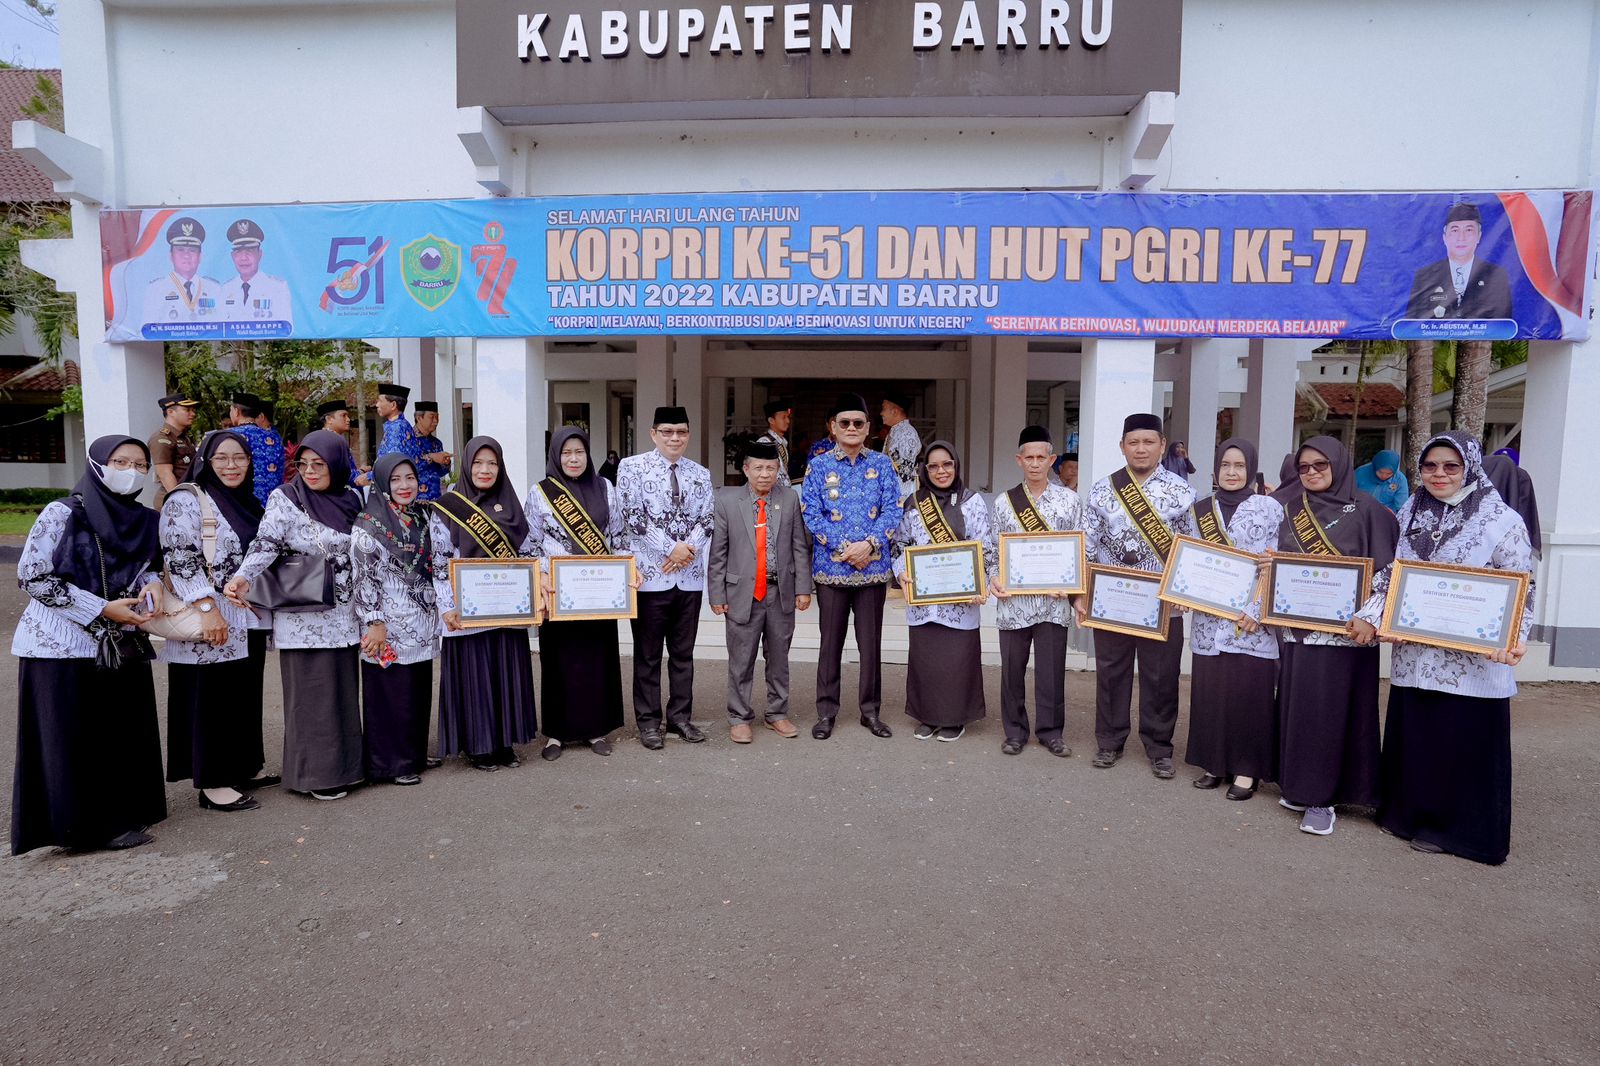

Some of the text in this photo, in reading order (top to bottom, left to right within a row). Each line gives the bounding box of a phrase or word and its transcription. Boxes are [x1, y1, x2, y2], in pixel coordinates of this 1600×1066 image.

[517, 0, 1113, 60] KABUPATEN BARRU
[547, 207, 800, 225] SELAMAT HARI ULANG TAHUN
[546, 225, 1368, 285] KORPRI KE-51 DAN HUT PGRI KE-77
[547, 283, 1000, 308] TAHUN 2022 KABUPATEN BARRU
[600, 314, 664, 330] MELAYANI,
[666, 314, 765, 328] BERKONTRIBUSI
[767, 315, 793, 327] DAN
[795, 315, 871, 328] BERINOVASI
[873, 315, 916, 328] UNTUK
[1060, 316, 1141, 334] BERINOVASI,
[1143, 319, 1216, 332] WUJUDKAN
[1217, 319, 1282, 334] MERDEKA
[466, 512, 499, 546] SEKOLAH
[553, 493, 582, 526] SEKOLAH
[574, 521, 608, 555] PENGGERA
[919, 497, 938, 525] SEKOLAH
[930, 521, 954, 544] PENGG
[1019, 507, 1044, 532] SEKOLA
[1120, 483, 1172, 554] SEKOLAH PENGGERA
[1293, 509, 1330, 556] SEKOLAH PEN
